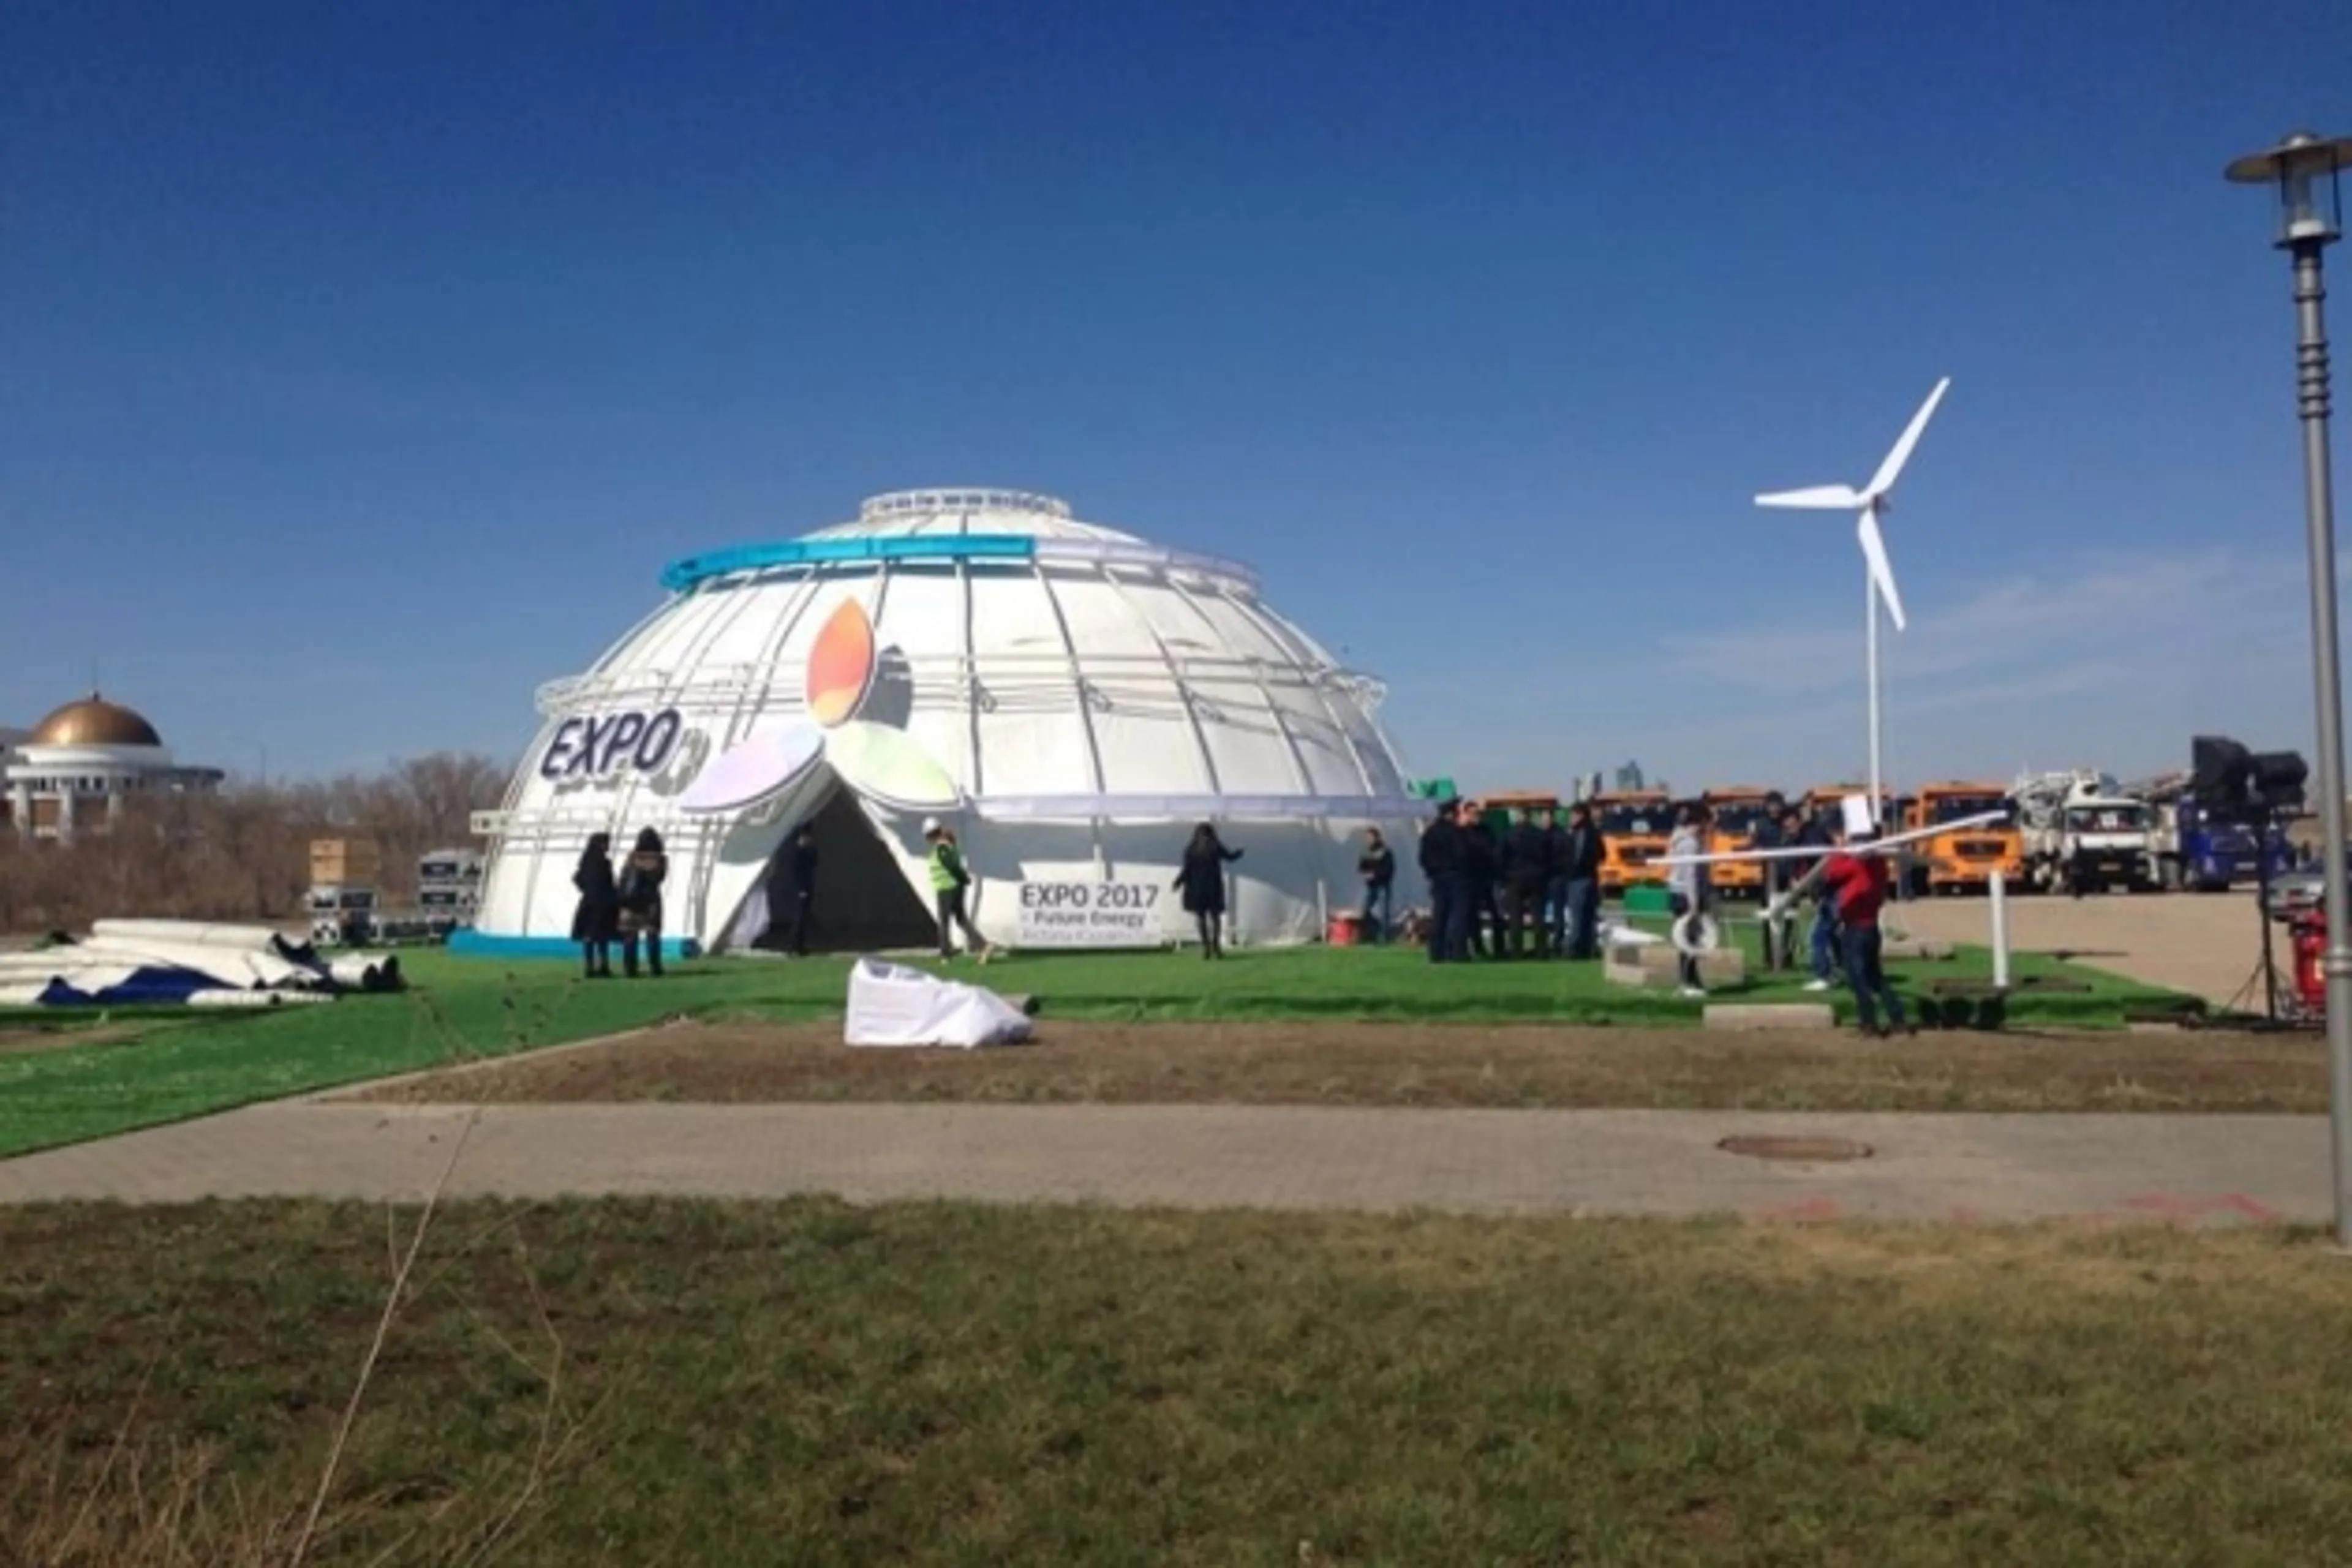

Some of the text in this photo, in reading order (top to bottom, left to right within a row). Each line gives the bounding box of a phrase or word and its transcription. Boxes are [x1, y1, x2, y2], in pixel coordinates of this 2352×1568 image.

[541, 708, 680, 778] EXPO
[1021, 884, 1159, 908] EXPO 2017
